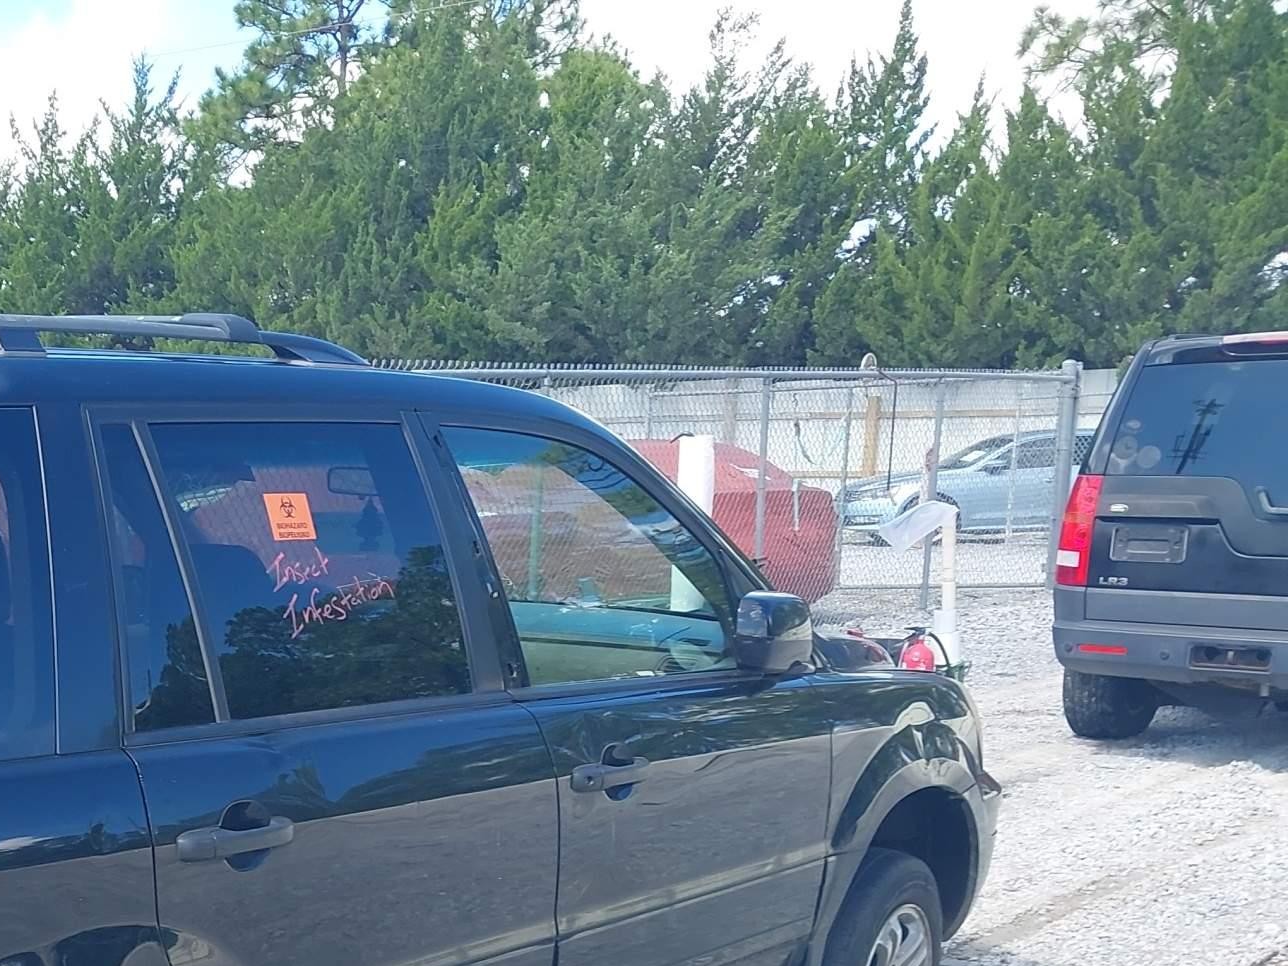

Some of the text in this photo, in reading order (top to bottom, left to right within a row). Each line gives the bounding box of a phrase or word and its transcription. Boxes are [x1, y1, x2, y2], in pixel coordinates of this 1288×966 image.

[266, 546, 329, 593] Insect
[1098, 576, 1129, 586] LR3
[283, 572, 396, 639] Infestation
